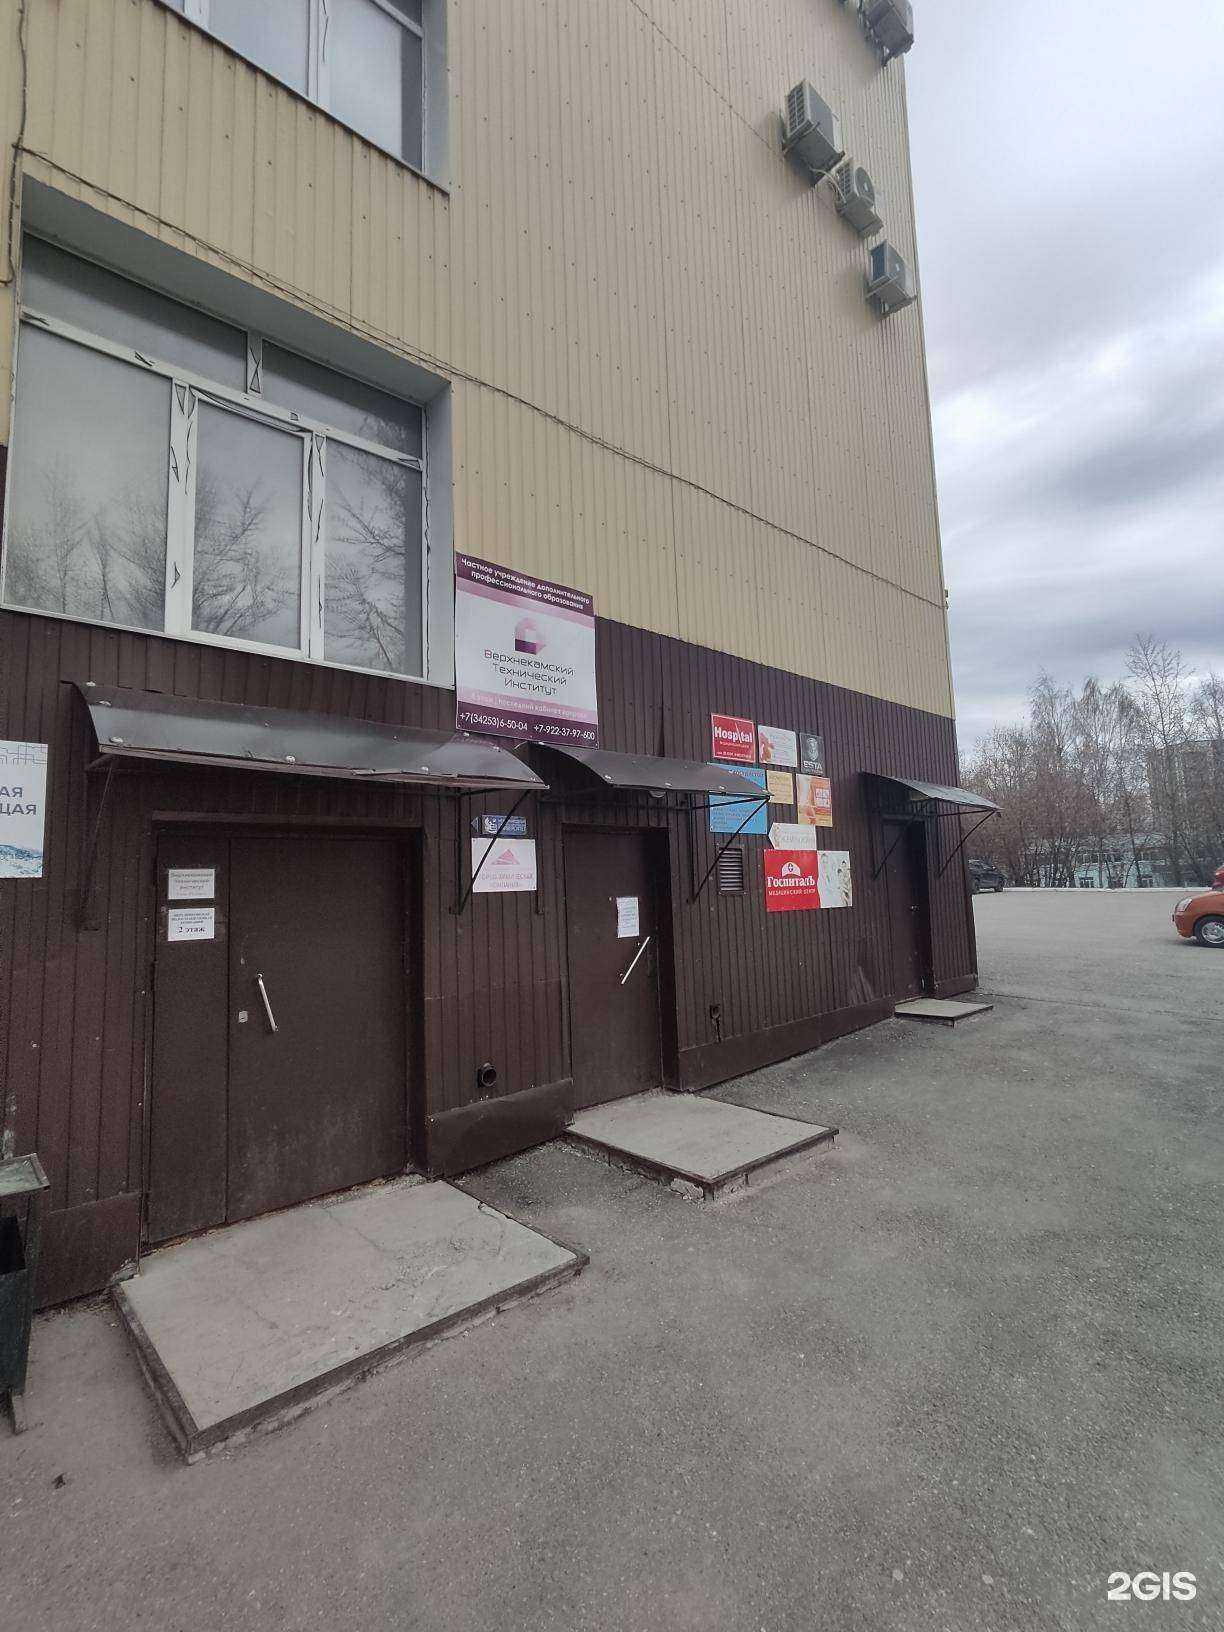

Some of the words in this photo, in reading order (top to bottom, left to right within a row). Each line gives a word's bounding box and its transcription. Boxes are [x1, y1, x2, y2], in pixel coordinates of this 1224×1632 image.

[461, 558, 493, 574] Частное
[494, 568, 536, 589] учреждение
[536, 582, 590, 604] дополнительного
[471, 571, 542, 598] профессионального
[543, 593, 584, 610] образования
[484, 649, 574, 676] Верхнекамский
[492, 662, 567, 686] Технический
[504, 679, 557, 695] Институт
[714, 725, 753, 744] Hospital
